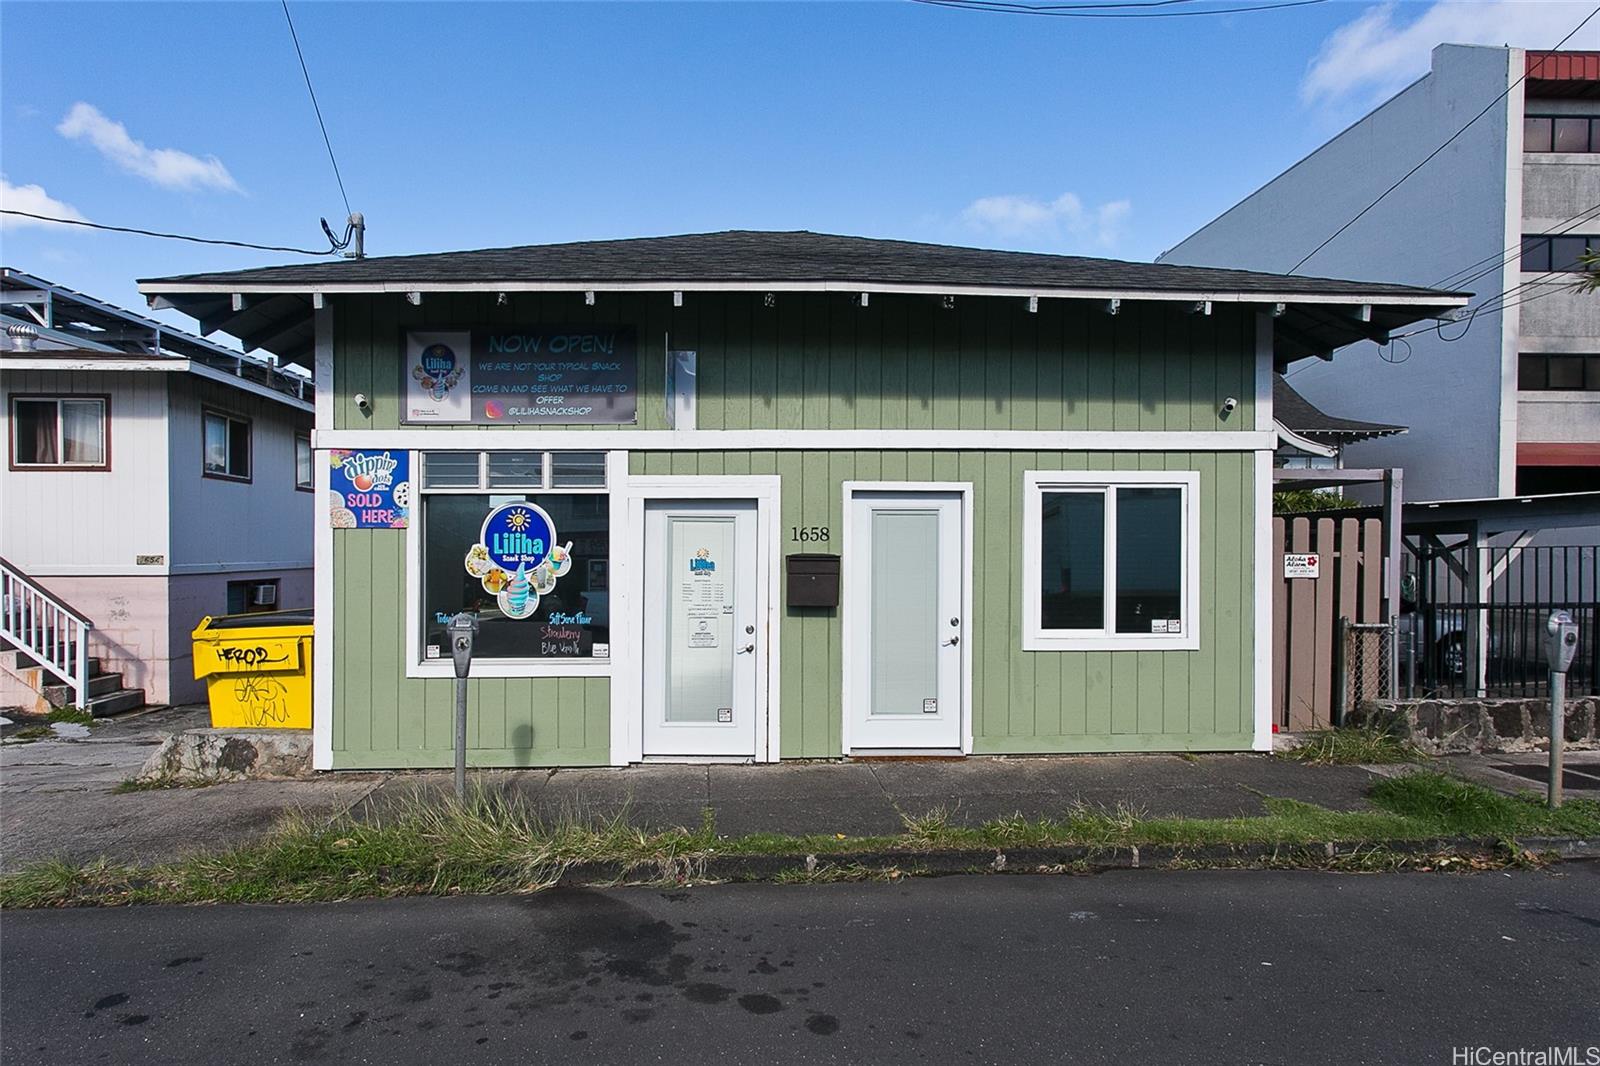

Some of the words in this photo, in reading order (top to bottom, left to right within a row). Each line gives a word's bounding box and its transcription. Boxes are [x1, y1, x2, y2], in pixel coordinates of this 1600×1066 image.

[489, 336, 542, 353] NOW
[549, 336, 615, 354] OPEN!
[425, 358, 452, 369] Liliha
[479, 362, 494, 371] WE
[495, 362, 511, 371] ARE
[513, 362, 531, 371] NOT
[533, 362, 557, 371] YOUR
[558, 362, 588, 371] TYPICAL
[592, 362, 621, 371] SNACK
[538, 373, 563, 382] SHOP
[472, 384, 499, 393] COME
[501, 384, 510, 393] IN
[511, 384, 529, 393] AND
[530, 384, 548, 393] SEE
[550, 384, 573, 393] WHAT
[575, 384, 590, 393] WE
[592, 384, 613, 393] HAVE
[615, 384, 627, 393] TO
[536, 395, 564, 404] OFFER
[508, 406, 593, 416] @LILIHASNACKSHOP
[344, 452, 397, 480] dippin'
[371, 473, 392, 485] dots
[347, 493, 382, 508] SOLD
[361, 509, 395, 524] HERE
[791, 526, 830, 542] 1658
[493, 532, 544, 555] Liliha
[502, 554, 520, 563] Snack
[520, 554, 536, 564] Shop
